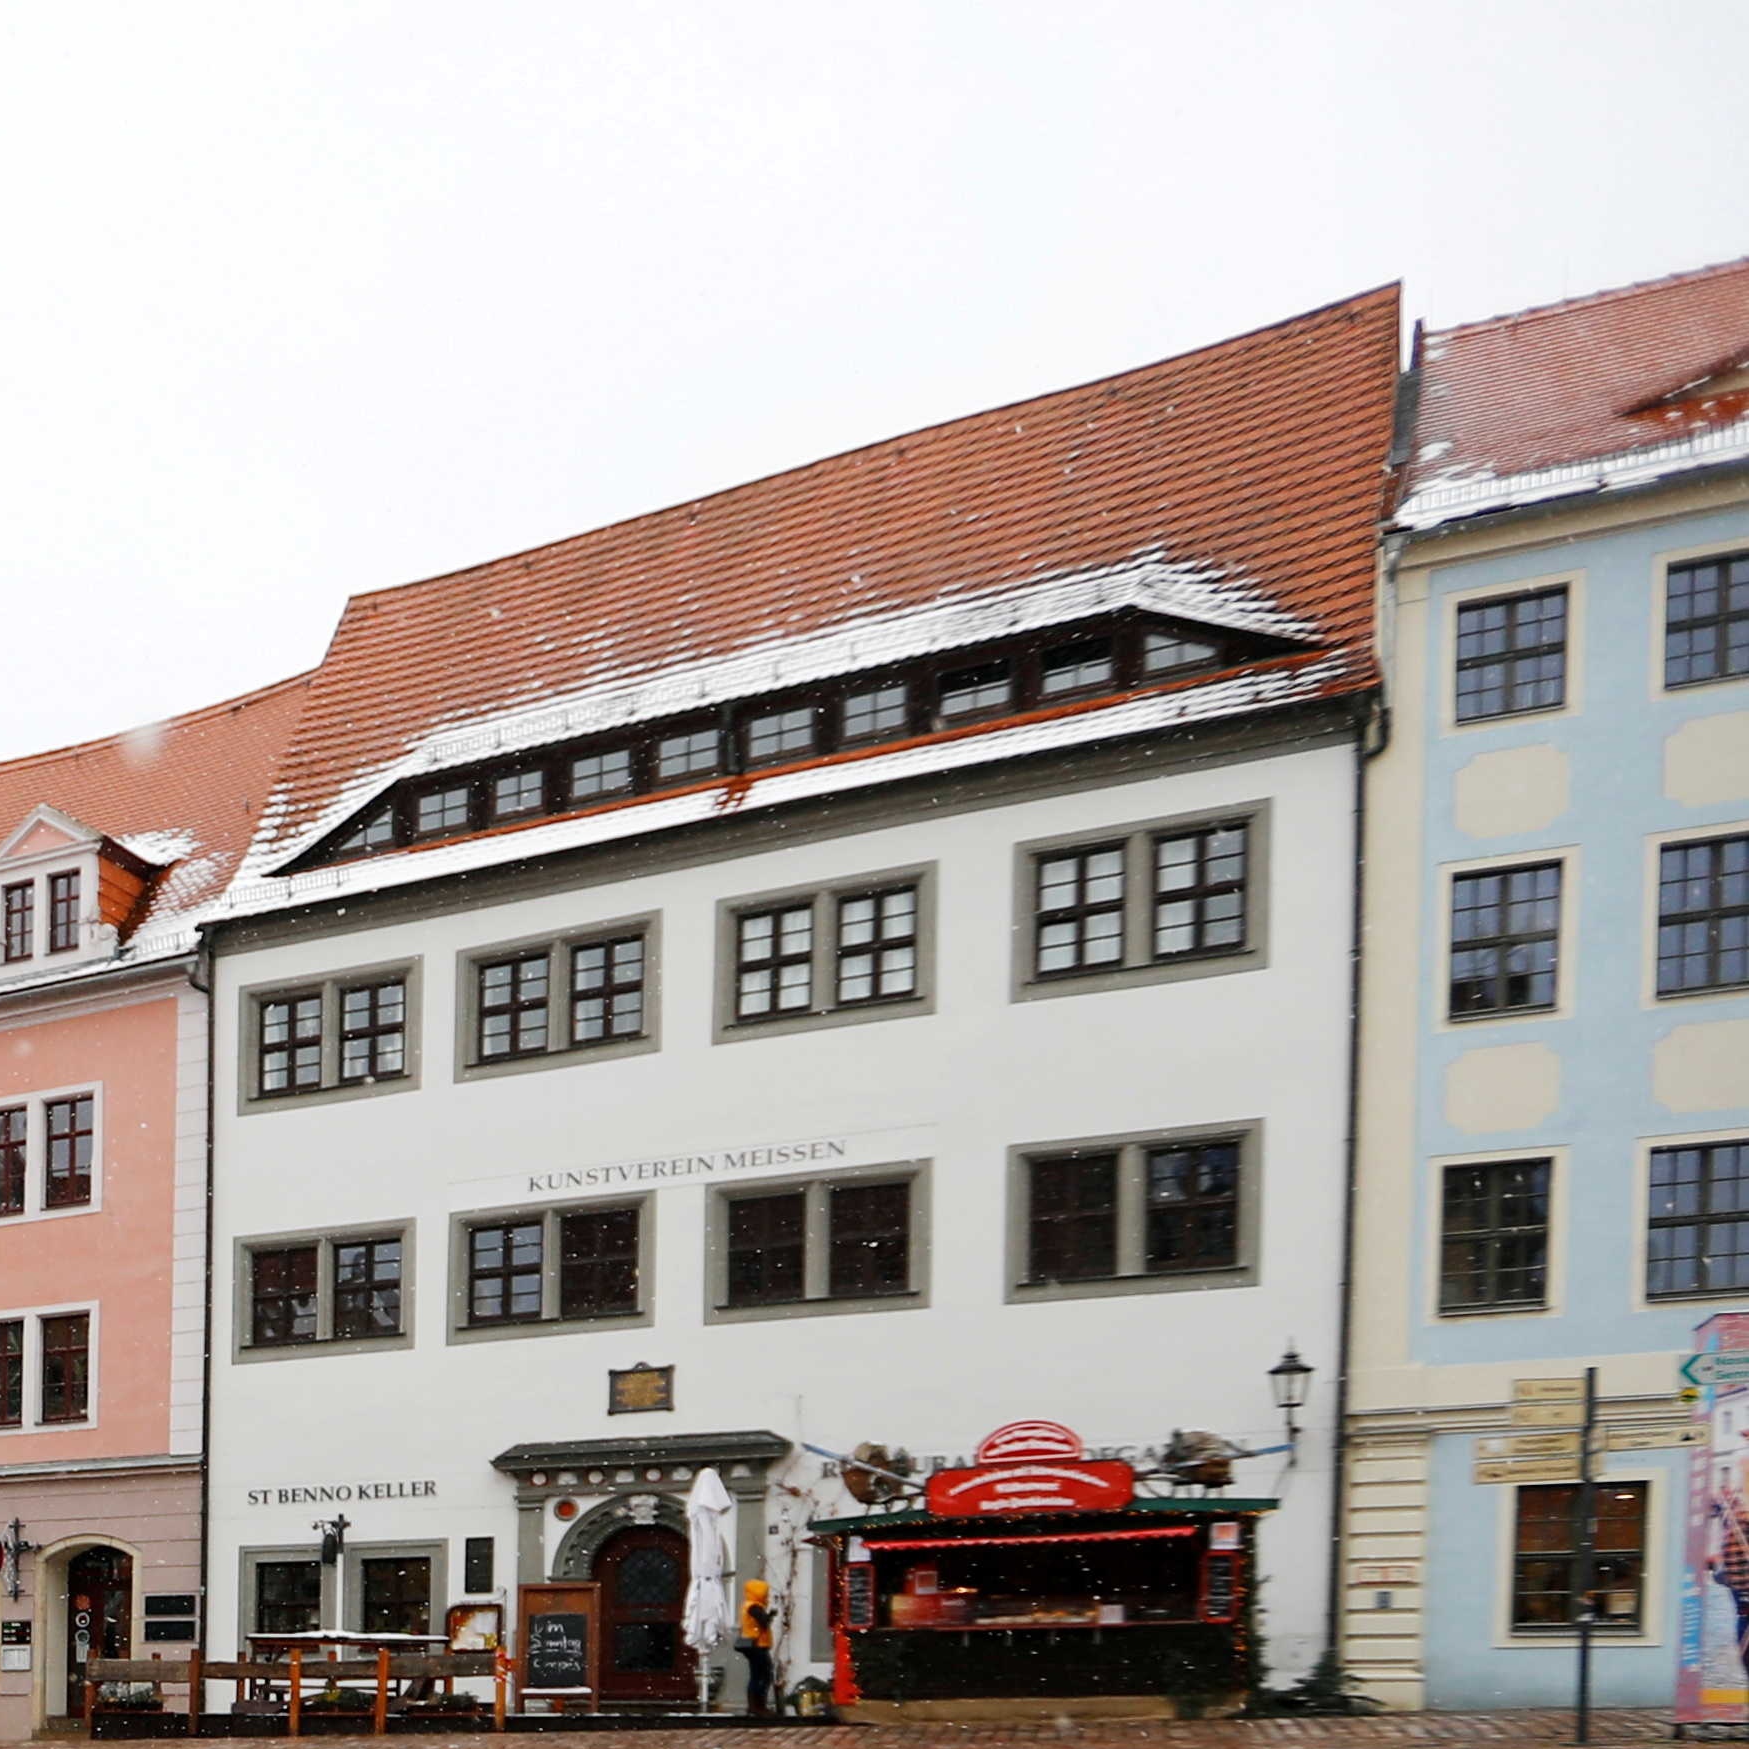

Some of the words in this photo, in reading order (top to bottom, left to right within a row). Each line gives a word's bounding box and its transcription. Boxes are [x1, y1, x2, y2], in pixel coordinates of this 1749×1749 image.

[528, 1154, 715, 1193] KUNSTVEREIN
[722, 1138, 847, 1170] MEISSEN
[247, 1489, 272, 1505] ST
[278, 1484, 352, 1504] BENNO
[358, 1479, 438, 1500] KELLER
